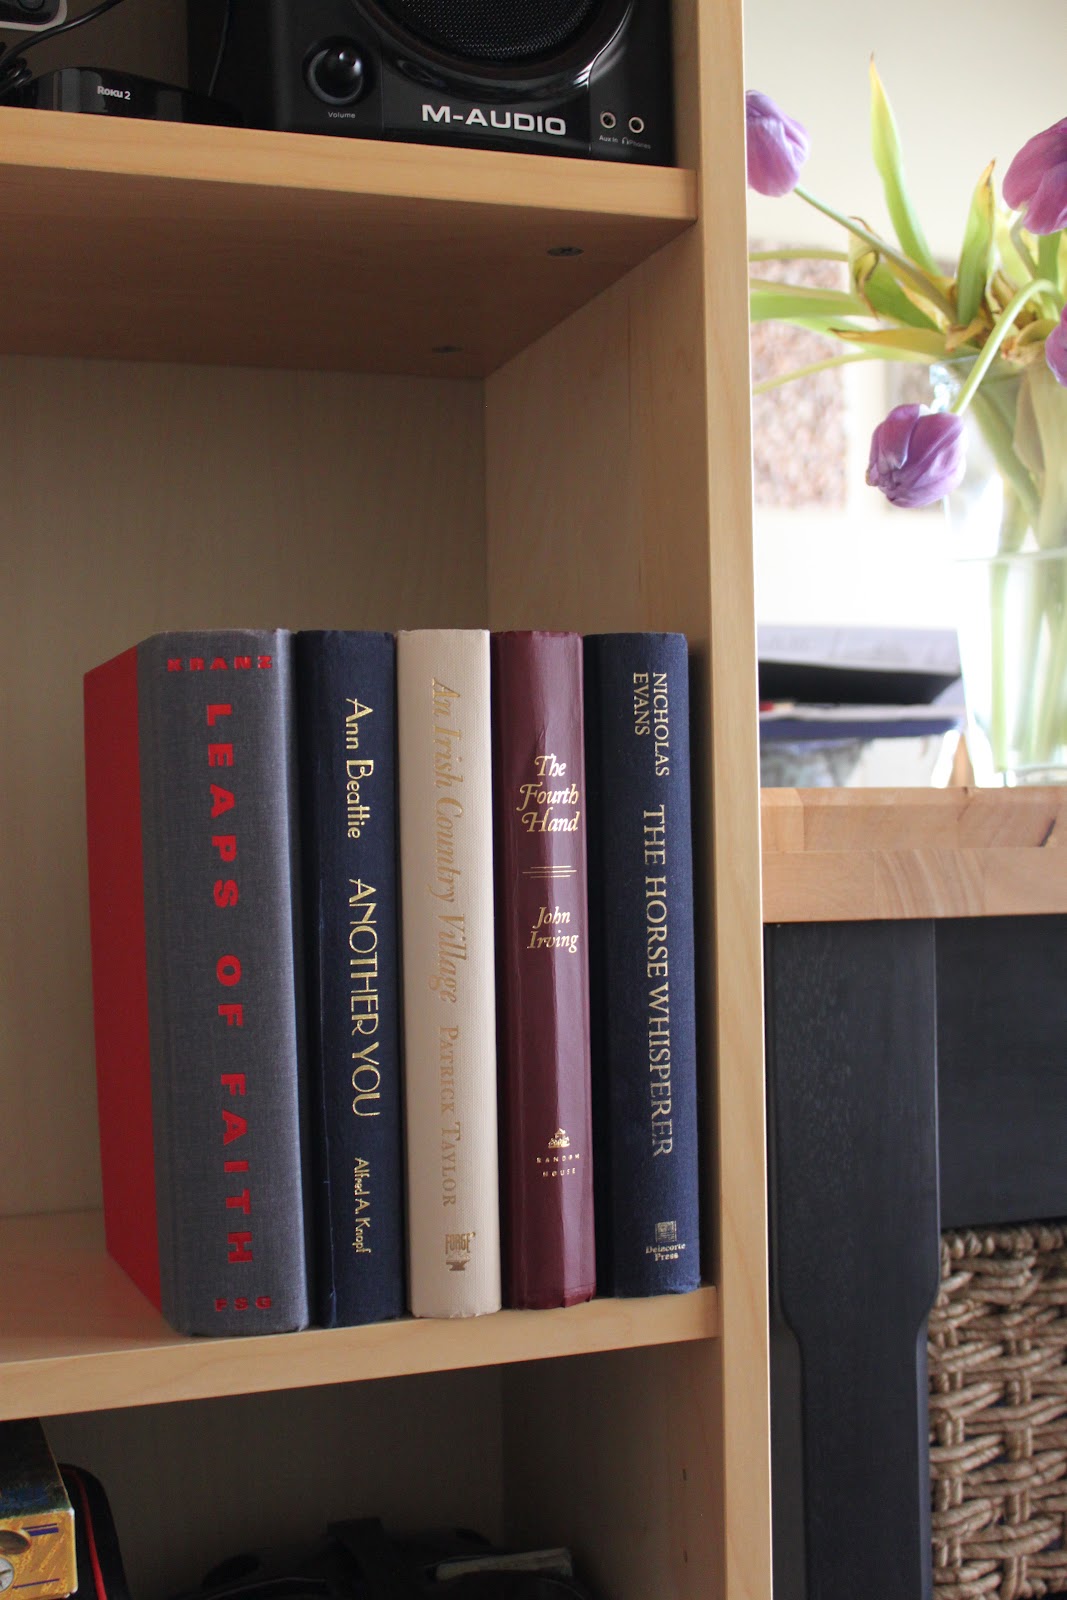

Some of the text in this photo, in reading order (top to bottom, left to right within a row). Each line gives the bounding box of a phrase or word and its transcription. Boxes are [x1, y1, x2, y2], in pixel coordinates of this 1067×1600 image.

[97, 86, 131, 100] Roku 2
[327, 111, 356, 119] Volume
[421, 104, 567, 136] M-AUDIO
[167, 656, 272, 672] KRANZ
[633, 672, 650, 736] EVANS
[652, 672, 669, 777] NICHOLAS
[346, 698, 374, 839] Ann Beattie
[534, 754, 567, 778] The
[516, 783, 579, 811] Fourth
[521, 807, 580, 833] Hand
[427, 677, 467, 1003] An Irish Country Village
[532, 906, 571, 929] John
[526, 931, 579, 953] Irving
[207, 704, 253, 1264] LEAPS OF FAITH
[643, 804, 673, 1158] THE HORSE WHISPERER
[349, 878, 381, 1117] ANOTHER YOU
[439, 1025, 461, 1207] PATRICK TAYLOR
[536, 1153, 581, 1164] RANDOM
[542, 1167, 577, 1177] HOUSE
[354, 1157, 371, 1254] Alfred A. Knopf
[654, 1252, 679, 1262] Press
[215, 1296, 272, 1312] FSG
